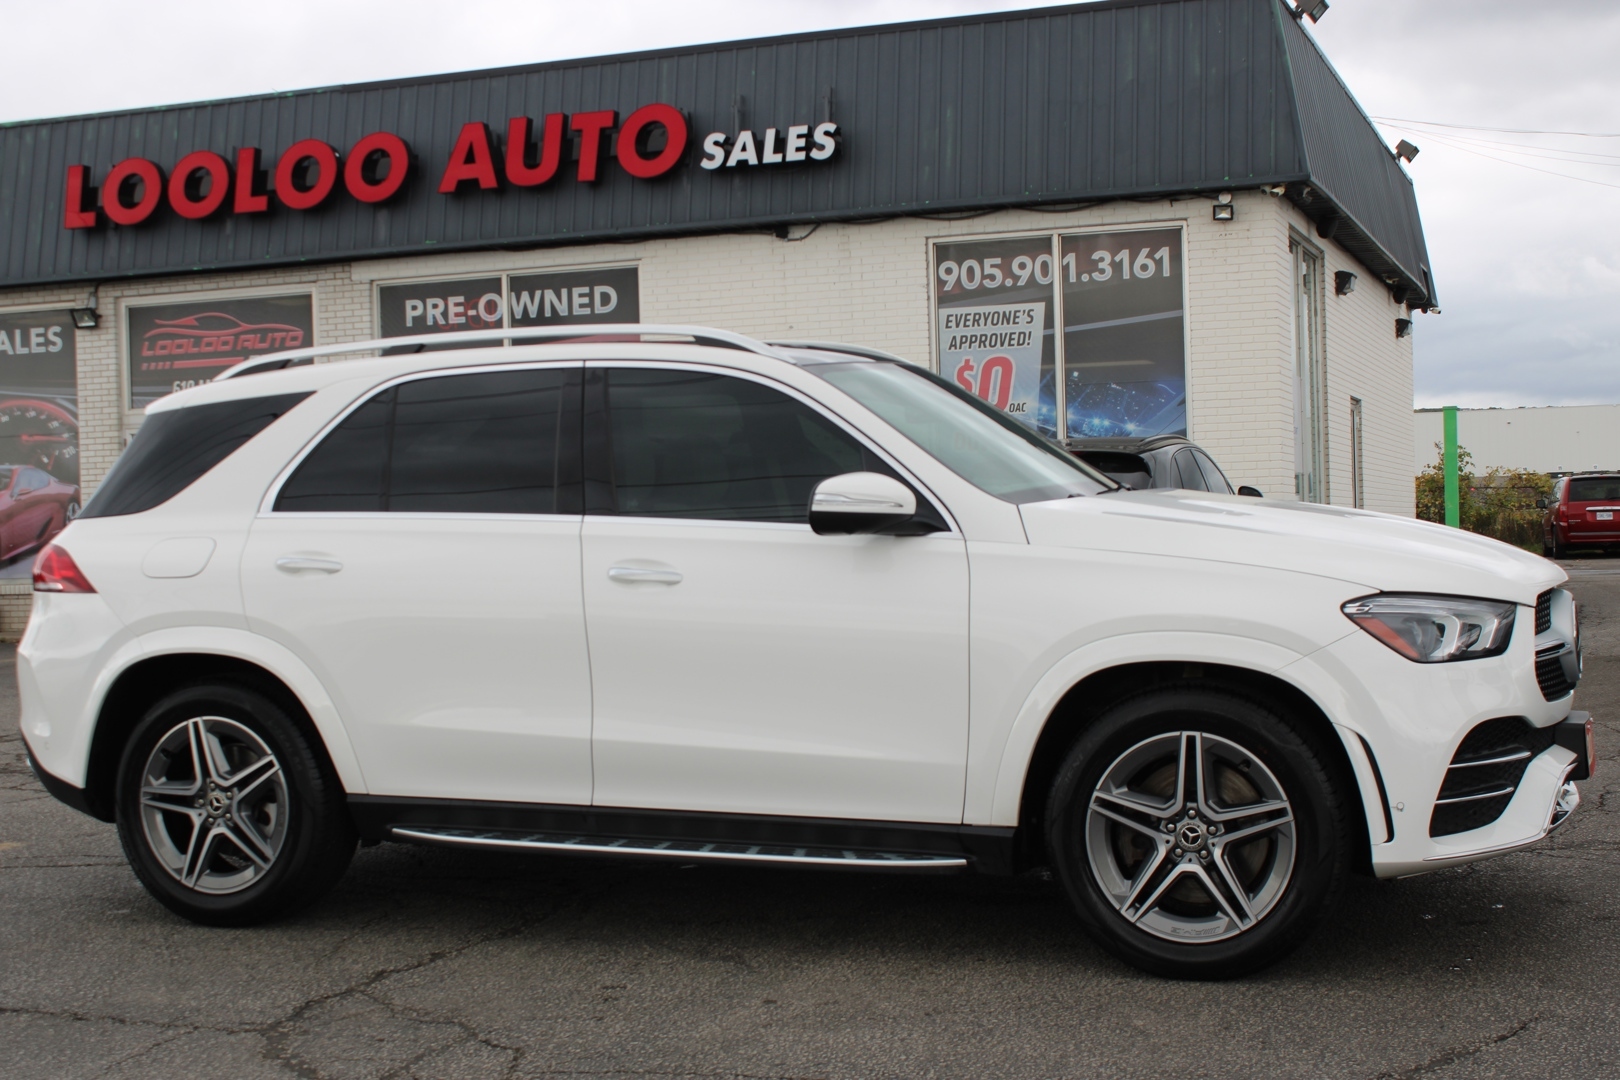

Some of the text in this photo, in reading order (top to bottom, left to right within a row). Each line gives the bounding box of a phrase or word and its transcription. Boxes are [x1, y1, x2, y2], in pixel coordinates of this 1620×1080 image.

[64, 103, 839, 230] LOOLOO AUTO SALES
[937, 246, 1171, 292] 905.901.3161
[405, 285, 618, 328] PRE-OWNED
[945, 309, 1035, 329] EVERYONE'S
[141, 331, 304, 356] LOOLOO AUTO
[948, 331, 1032, 351] APPROVED!
[1008, 402, 1027, 413] OAC
[62, 445, 77, 459] 210
